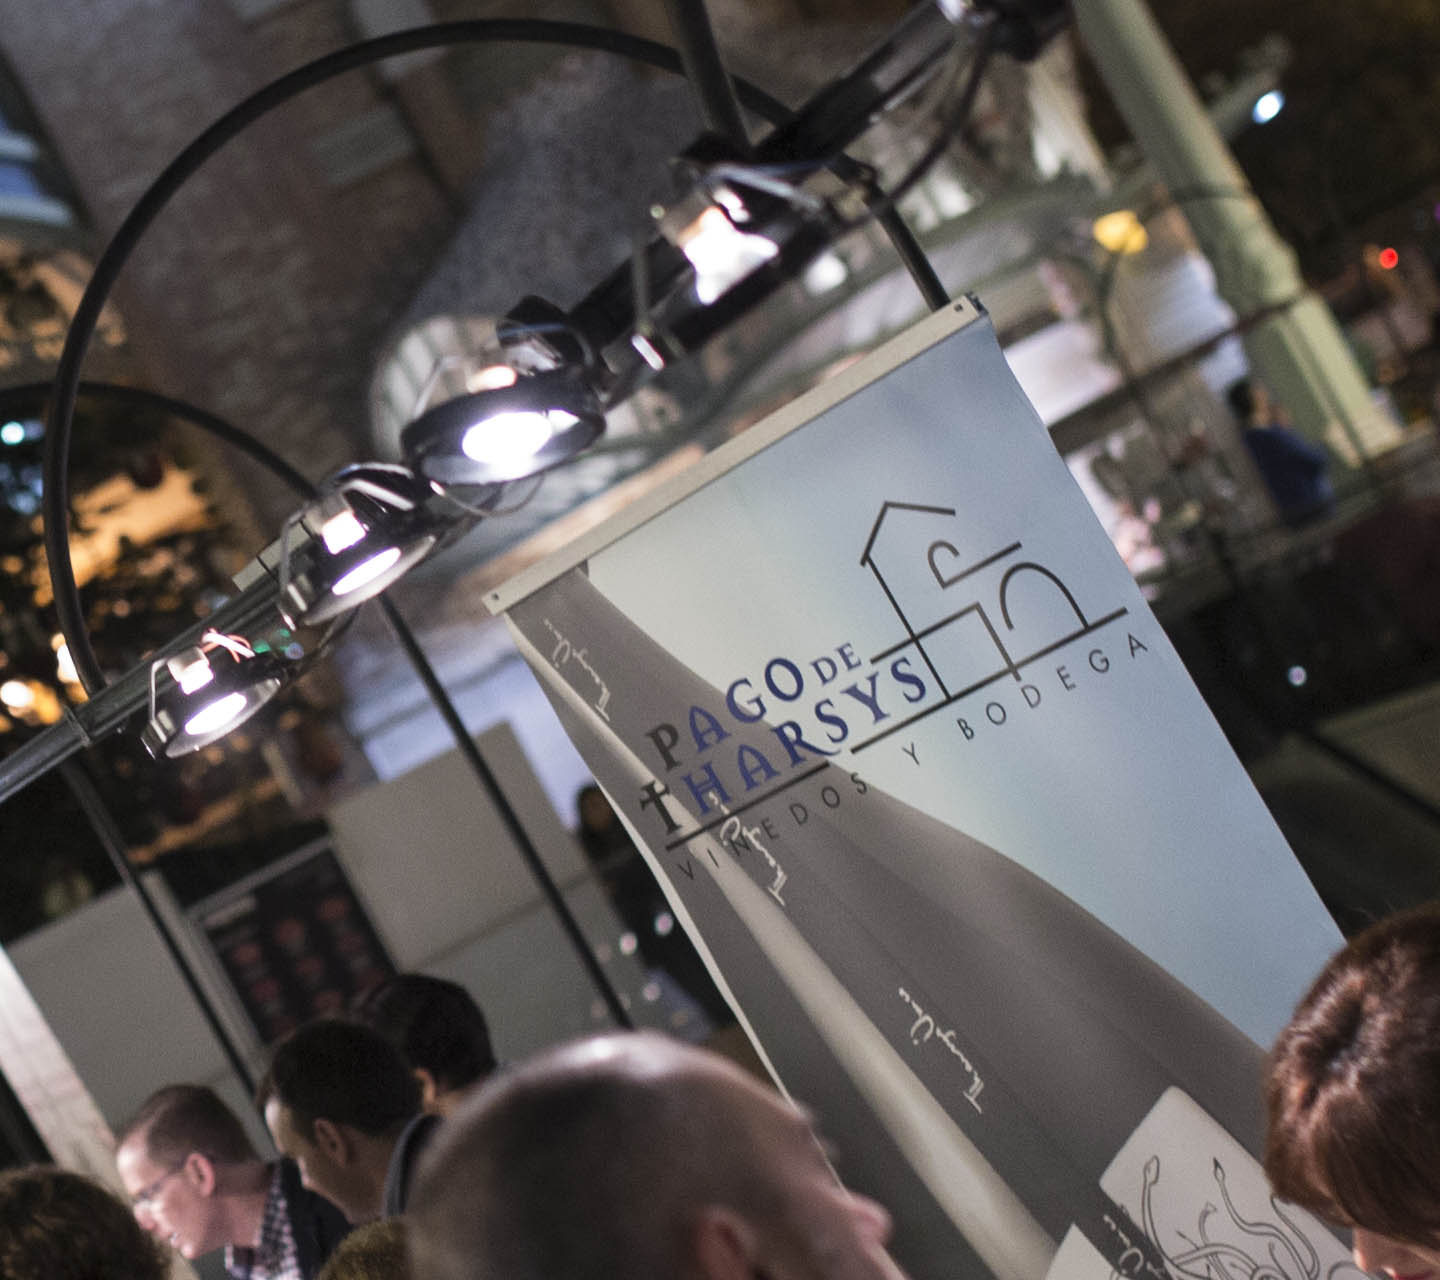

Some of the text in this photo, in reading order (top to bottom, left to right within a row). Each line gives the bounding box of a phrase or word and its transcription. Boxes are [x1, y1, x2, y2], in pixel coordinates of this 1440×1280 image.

[639, 655, 927, 835] THARSYS
[644, 642, 862, 772] PAGO DE
[901, 741, 921, 767] Y
[956, 632, 1149, 741] BODEGA
